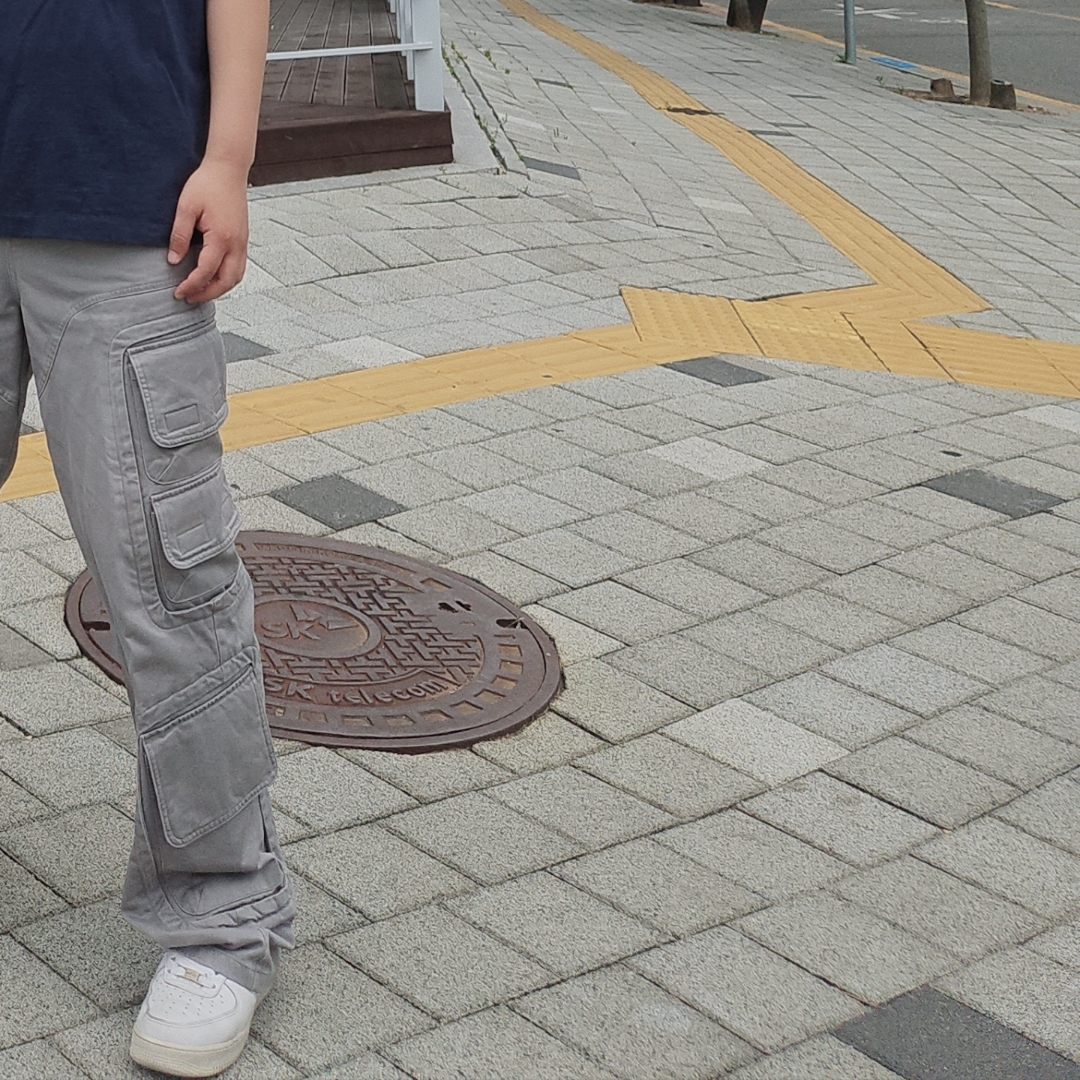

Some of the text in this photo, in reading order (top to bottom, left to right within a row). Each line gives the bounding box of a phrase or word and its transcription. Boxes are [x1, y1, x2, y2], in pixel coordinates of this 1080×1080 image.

[260, 621, 321, 641] SK
[264, 676, 449, 705] SK telecom
